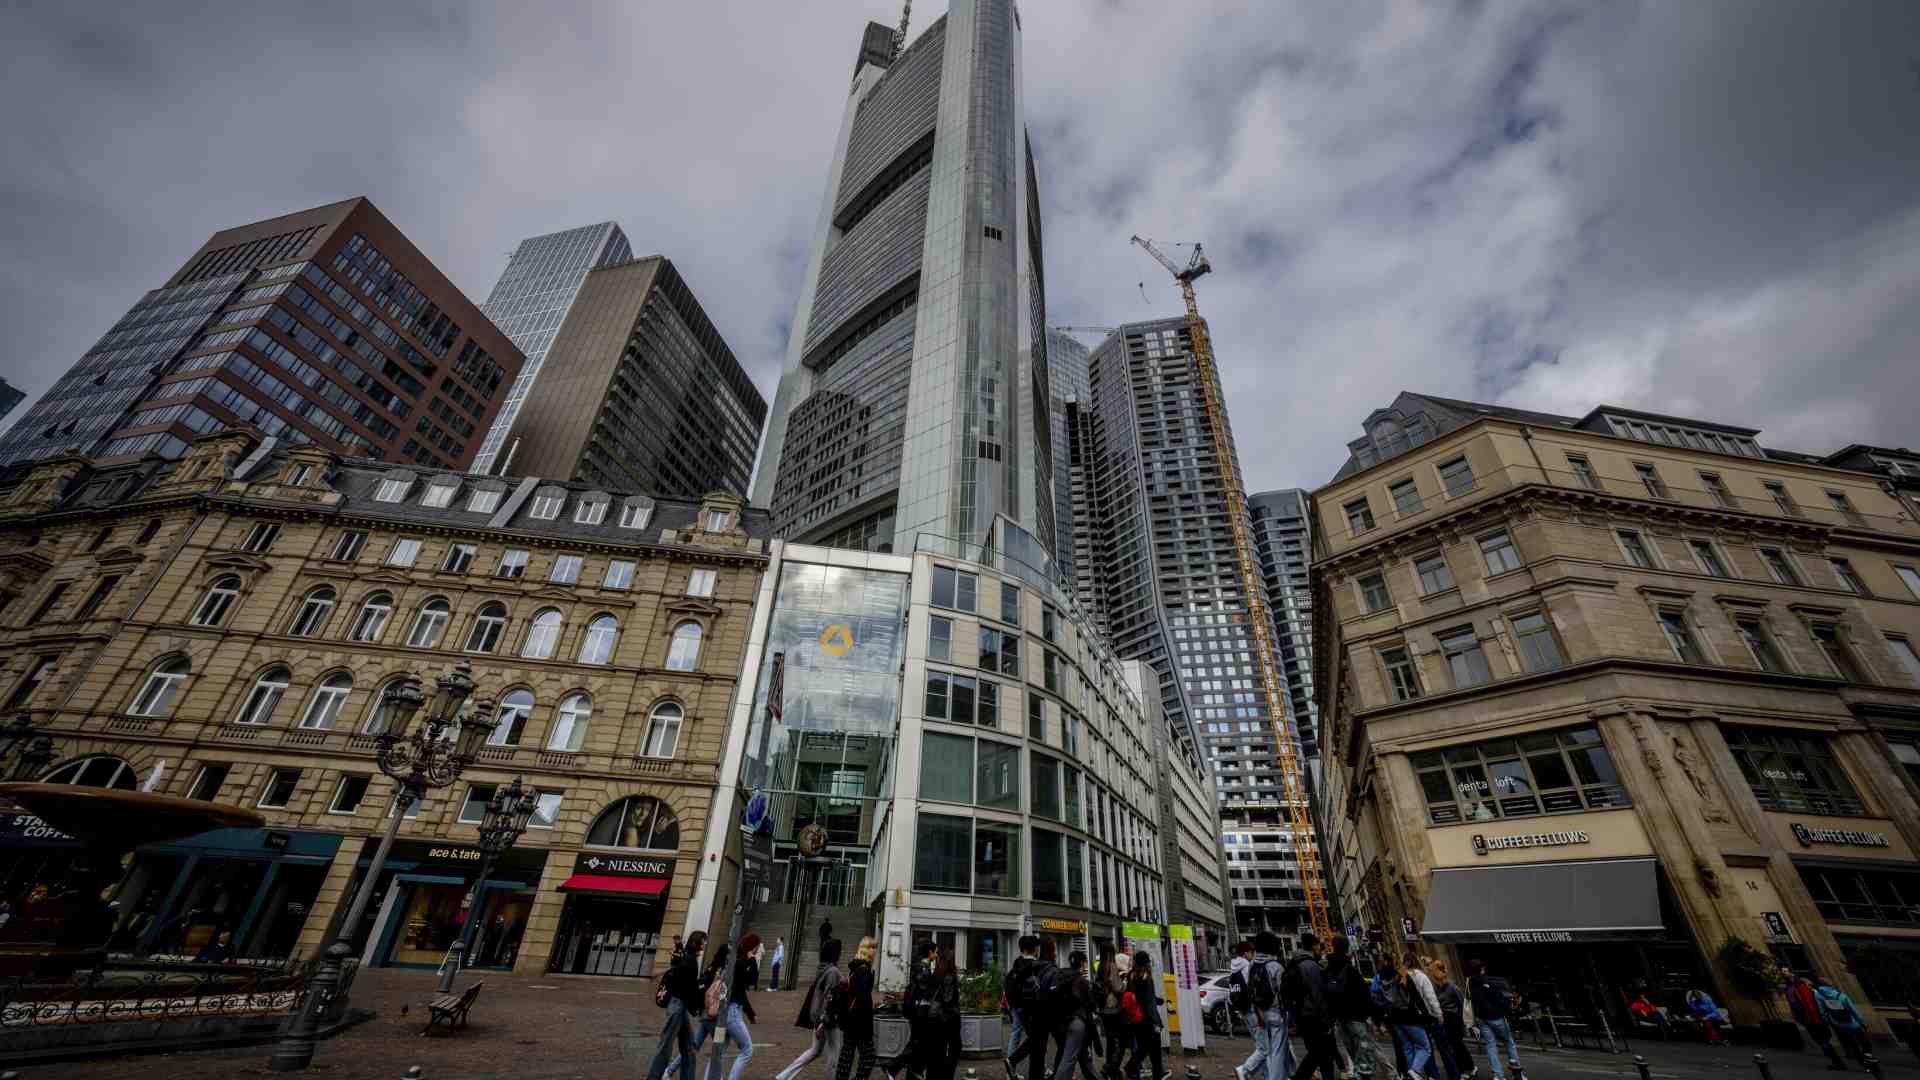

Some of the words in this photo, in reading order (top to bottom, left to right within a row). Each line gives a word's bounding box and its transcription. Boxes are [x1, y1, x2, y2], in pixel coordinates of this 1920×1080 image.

[1457, 780, 1488, 792] denta
[1487, 836, 1532, 849] COFFEE
[1534, 831, 1588, 846] FELLOWS
[429, 848, 449, 858] ace
[450, 848, 458, 859] &
[608, 860, 667, 874] NIESSING
[1500, 933, 1532, 943] COFFEE
[1532, 931, 1572, 942] FELLOWS
